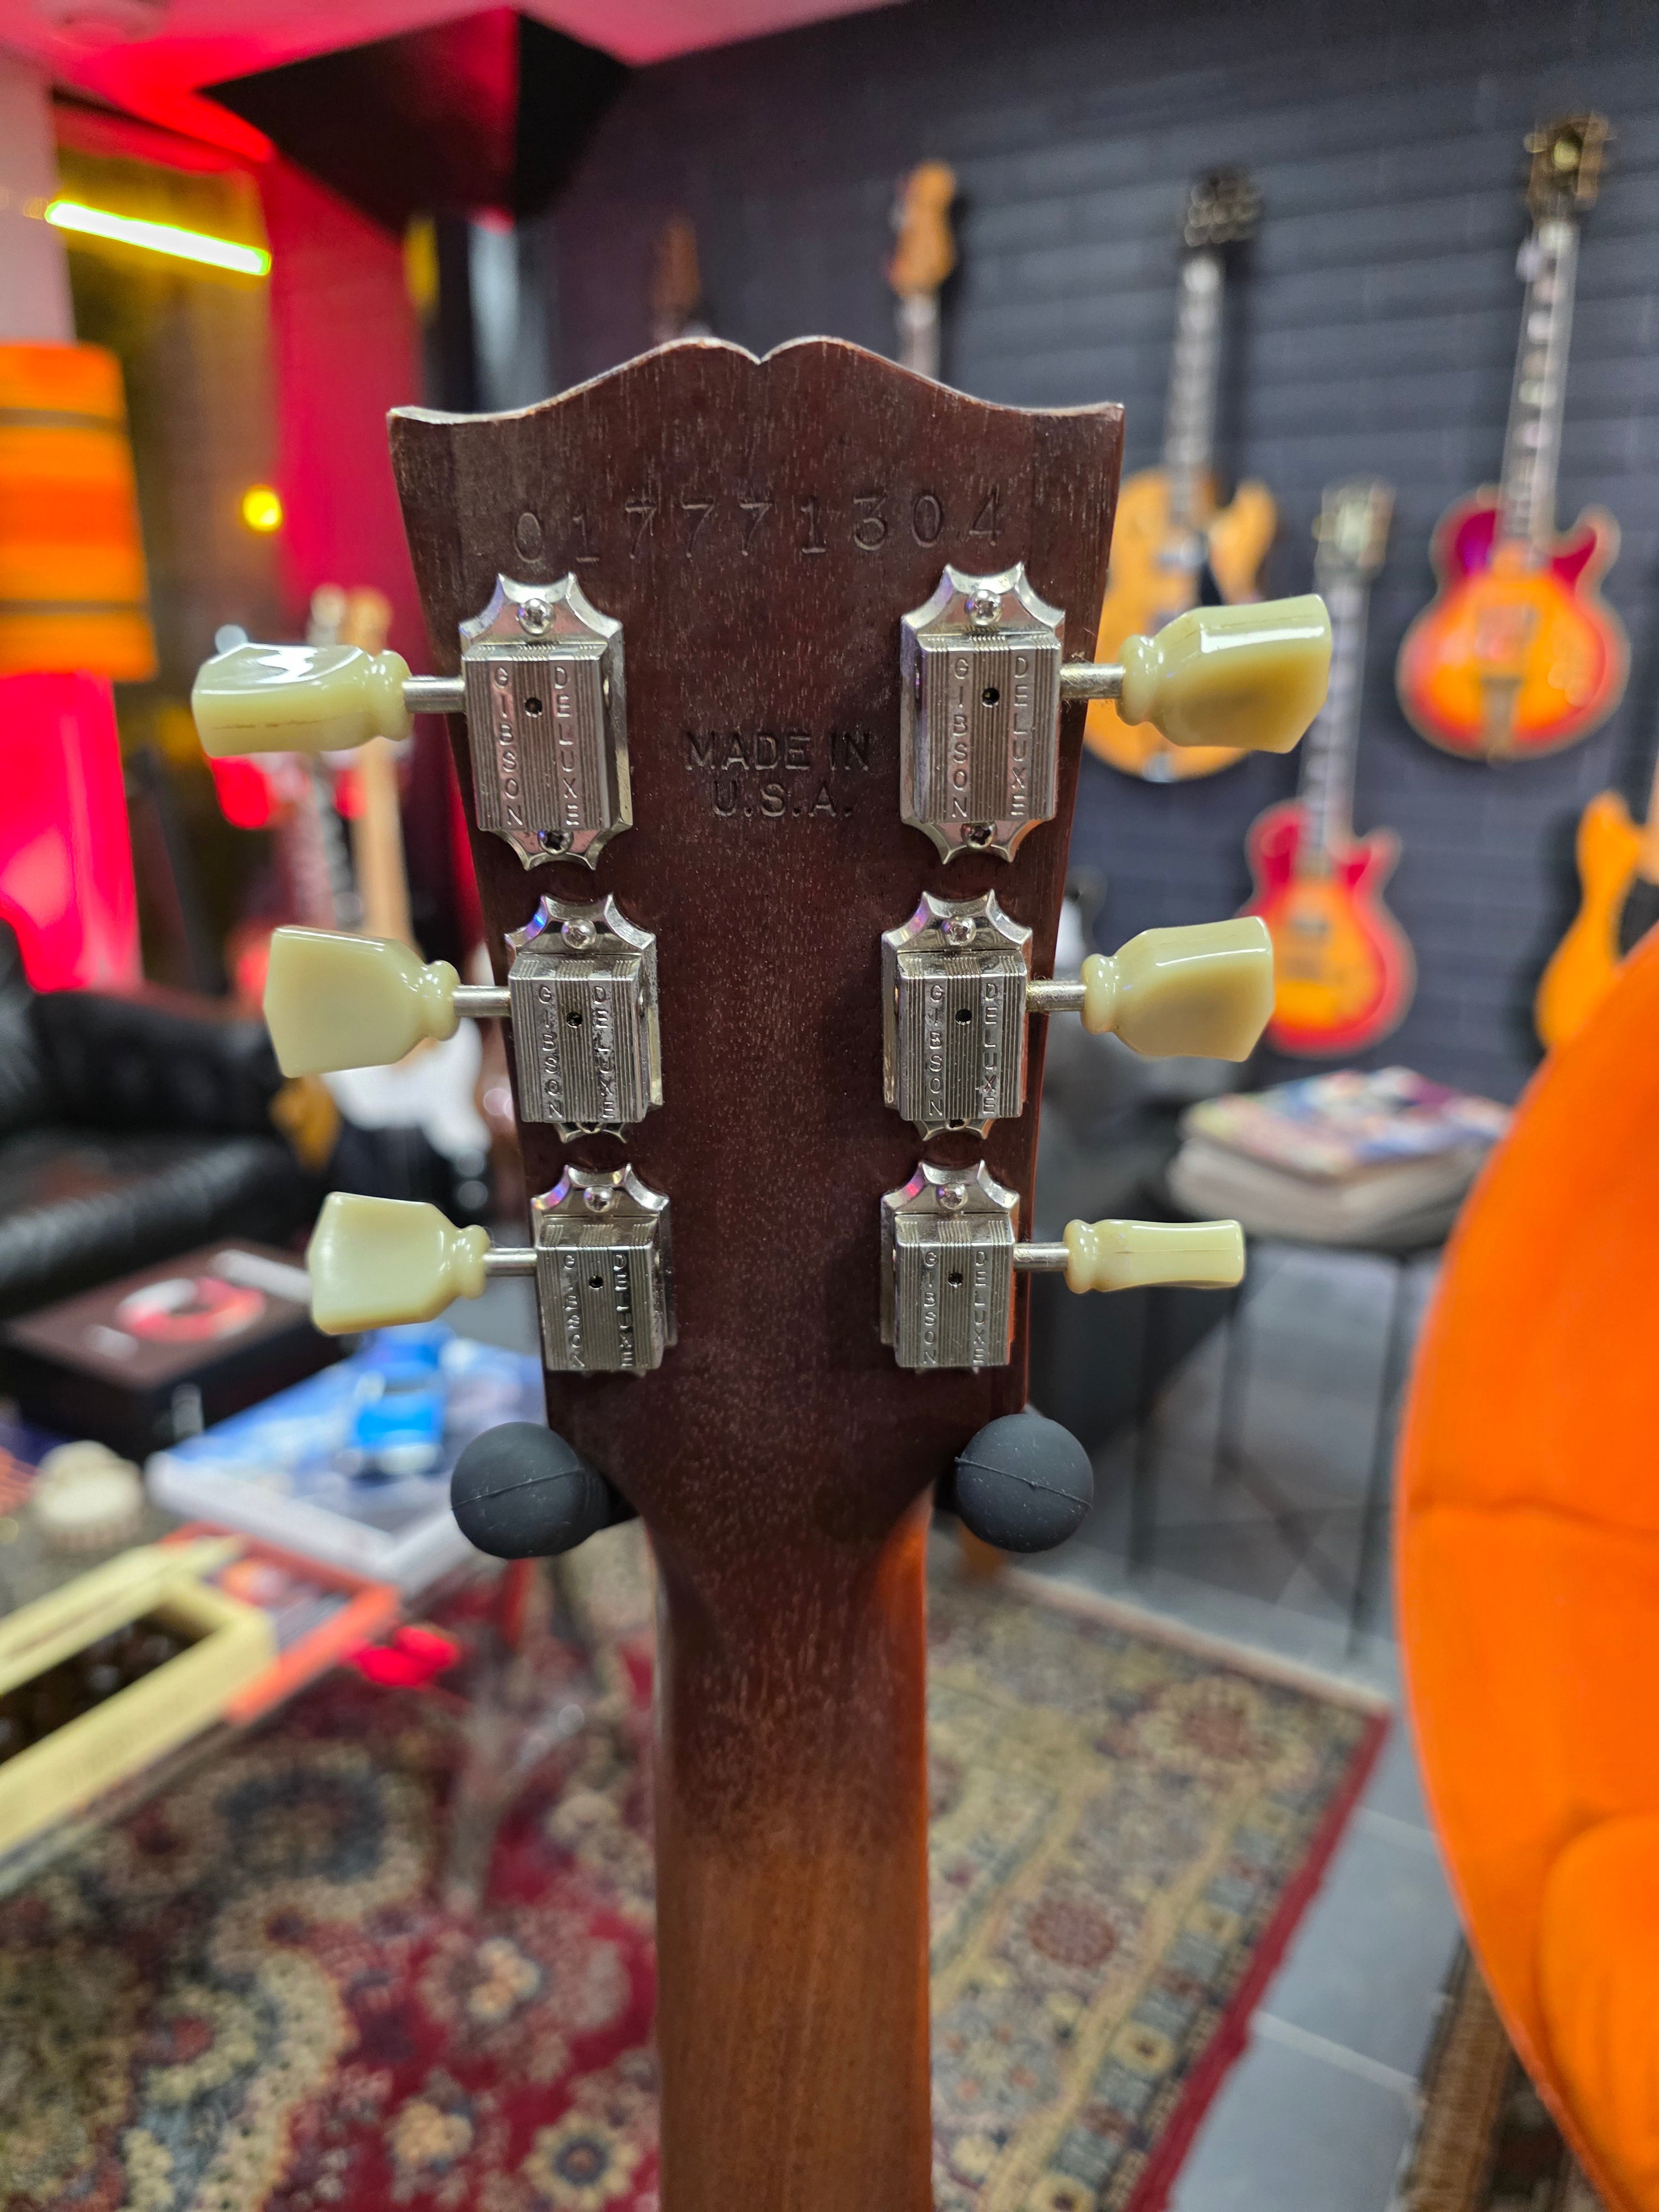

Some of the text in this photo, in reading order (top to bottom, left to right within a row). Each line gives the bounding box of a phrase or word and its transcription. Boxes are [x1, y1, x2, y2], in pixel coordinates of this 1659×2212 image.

[554, 666, 580, 826] DELUXE
[685, 731, 870, 771] MADE IN
[712, 779, 852, 817] U.S.A.
[952, 659, 969, 818] GIBSON
[1011, 657, 1028, 816] DELUXE
[929, 984, 945, 1117] GIBSON
[982, 983, 998, 1114] DELUXE
[924, 1251, 937, 1364] GIBSON
[973, 1251, 987, 1363] DELUXE
